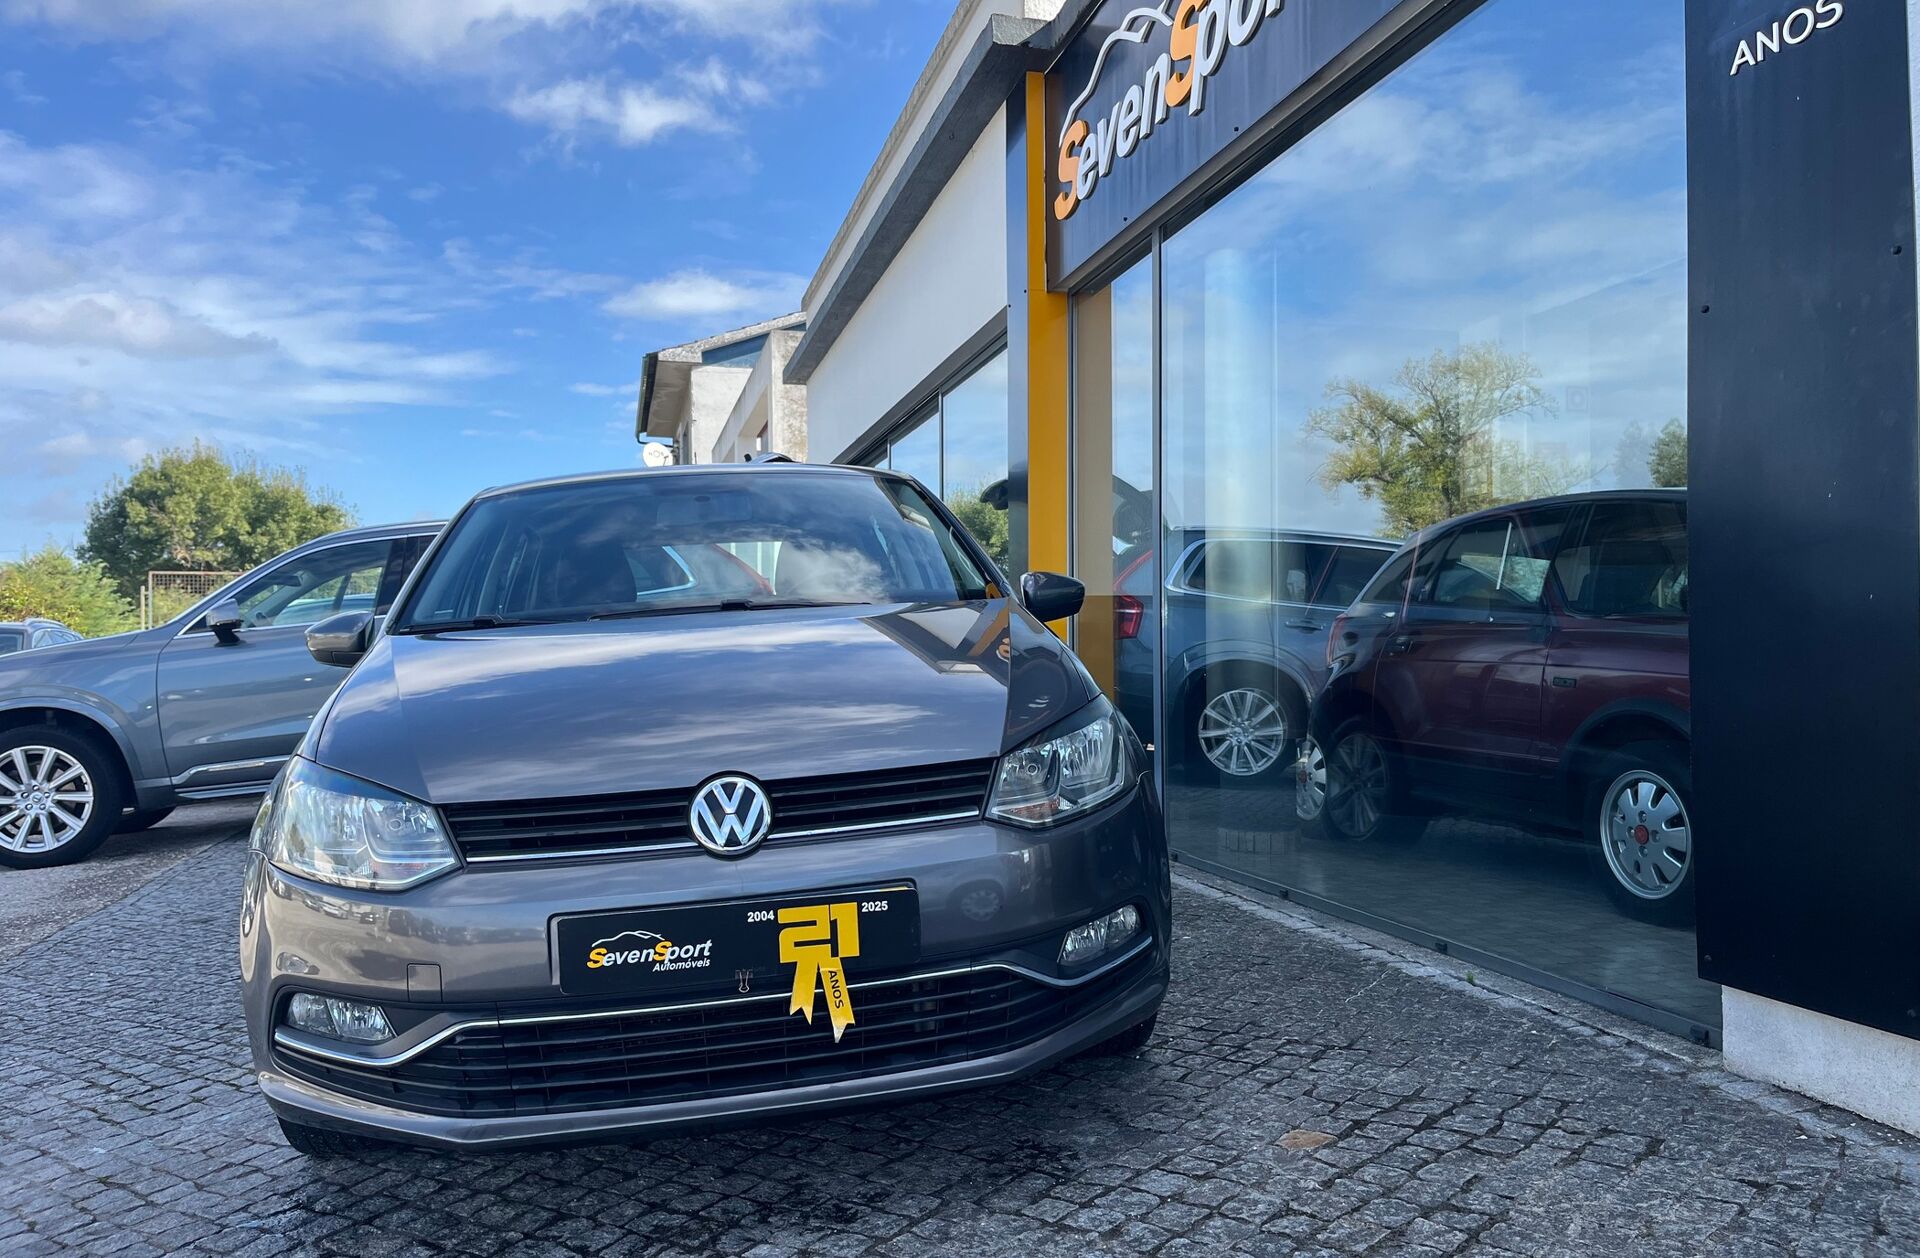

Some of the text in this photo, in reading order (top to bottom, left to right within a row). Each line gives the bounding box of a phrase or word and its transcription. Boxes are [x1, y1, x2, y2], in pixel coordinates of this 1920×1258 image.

[1729, 0, 1845, 76] ANOS
[694, 780, 767, 848] VW
[746, 909, 775, 922] 2004
[860, 900, 889, 913] 2025
[586, 938, 713, 969] SevenSport
[652, 957, 711, 972] Automóveis
[828, 969, 845, 1009] ANOS
